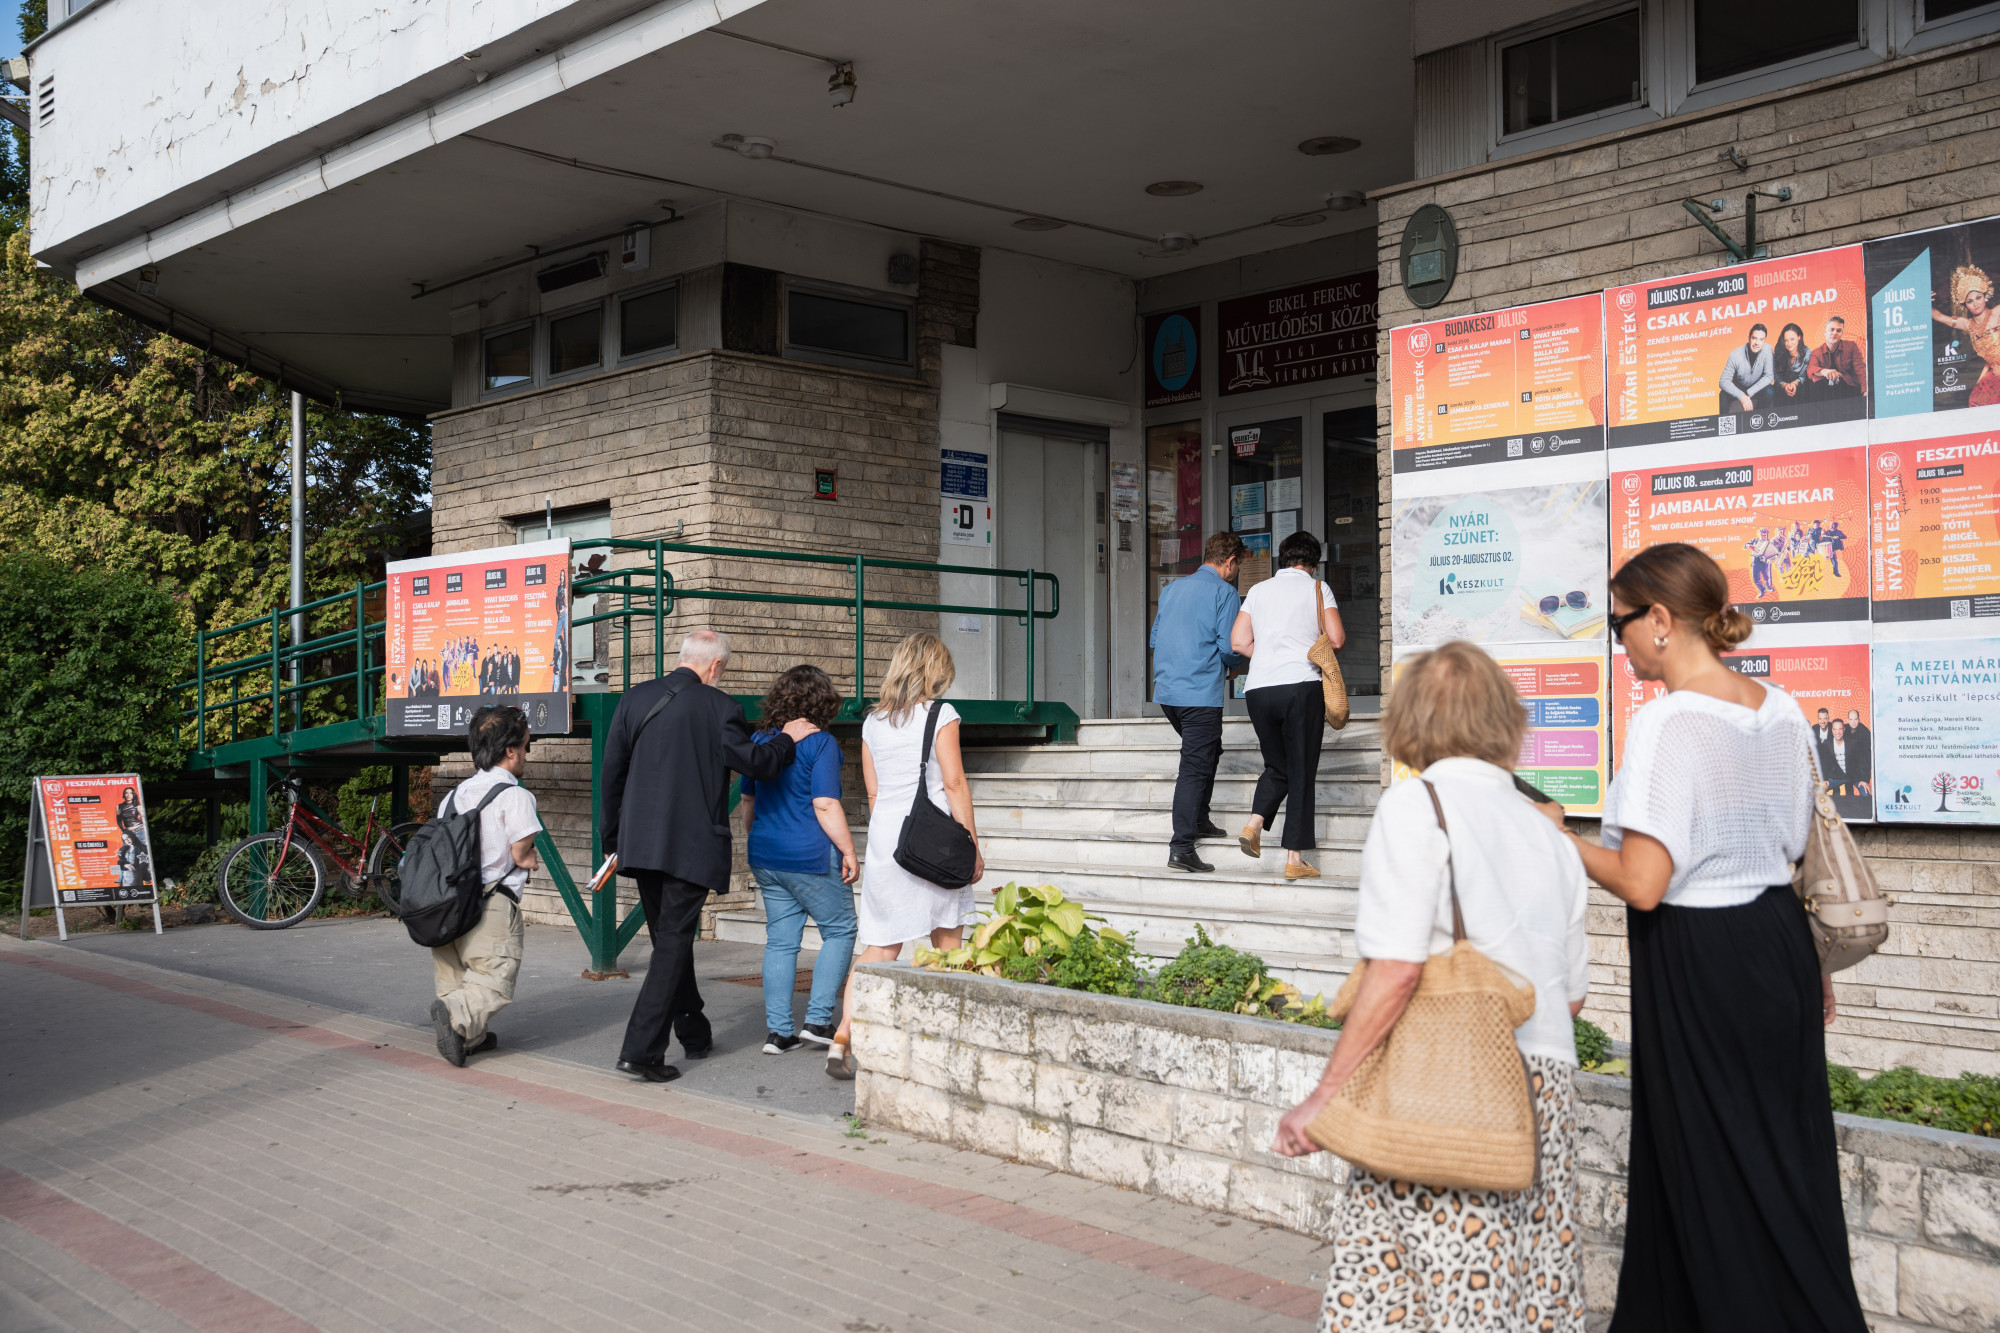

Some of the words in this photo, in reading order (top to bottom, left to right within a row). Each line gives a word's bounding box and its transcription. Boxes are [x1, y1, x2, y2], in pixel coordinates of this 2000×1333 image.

[1650, 288, 1679, 306] JÚLIUS
[1680, 286, 1695, 300] 07.
[1696, 288, 1714, 298] kedd
[1718, 278, 1744, 294] 20:00
[1754, 267, 1807, 288] BUDAKESZI
[1269, 294, 1307, 314] ERKEL
[1313, 283, 1361, 306] FERENC
[1884, 288, 1916, 305] JÚLIUS
[1647, 311, 1691, 331] CSAK
[1695, 309, 1707, 323] A
[1712, 300, 1768, 321] KALAP
[1773, 288, 1838, 311] MARAD
[1445, 316, 1495, 337] BUDAKESZI
[1497, 311, 1528, 329] JÚLIUS
[1884, 307, 1908, 328] 16.
[1227, 312, 1323, 348] MŰVELŐDÉSI
[1521, 330, 1530, 339] 09.
[1533, 332, 1551, 340] VIVAT
[1552, 327, 1580, 337] BACCHUS
[1647, 334, 1670, 346] ZENÉS
[1672, 330, 1708, 342] IRODALMI
[1709, 326, 1733, 339] JÁTÉK
[1885, 326, 1911, 335] csütörtök
[1621, 311, 1638, 365] ESTÉK
[1275, 344, 1315, 362] NAGY
[1436, 344, 1445, 353] 07.
[1448, 346, 1463, 354] CSAK
[1470, 342, 1489, 350] KALAP
[1490, 338, 1512, 347] MARAD
[1554, 346, 1570, 354] GÉZA
[1275, 364, 1323, 384] VÁROSI
[1413, 360, 1425, 399] ESTÉK
[1624, 371, 1638, 420] NYÁRI
[1935, 385, 1966, 394] BUDAKESZI
[1522, 394, 1531, 402] 10.
[1535, 395, 1551, 403] TÓTH
[1552, 392, 1572, 400] ABIGÉL
[1648, 397, 1666, 405] SZABÓ
[1439, 406, 1447, 414] 08.
[1450, 405, 1482, 416] JAMBALAYA
[1483, 401, 1510, 410] ZENEKAR
[1535, 403, 1555, 411] KISZEL
[1556, 399, 1584, 410] JENNIFER
[1415, 404, 1425, 441] NYÁRI
[1237, 444, 1256, 453] ALARM
[1916, 439, 2000, 463] FESZTIVÁL
[1654, 474, 1682, 491] JÚLIUS
[1684, 475, 1697, 488] 08.
[1700, 478, 1724, 487] szerda
[1725, 469, 1752, 485] 20:00
[1757, 464, 1809, 482] BUDAKESZI
[1918, 469, 1936, 479] JÚLIUS
[1938, 468, 1946, 477] 10.
[1920, 488, 1940, 496] 19:00
[1649, 496, 1747, 519] JAMBALAYA
[1752, 487, 1834, 508] ZENEKAR
[1882, 476, 1900, 532] ESTÉK
[1920, 497, 1940, 505] 19:15
[959, 504, 974, 529] D
[1450, 510, 1489, 528] NYÁRI
[1625, 496, 1641, 549] ESTÉK
[1671, 520, 1704, 529] ORLEANS
[1706, 518, 1729, 526] MUSIC
[1874, 520, 1883, 543] JÚLIUS
[1942, 519, 1970, 530] TÓTH
[1444, 530, 1499, 546] SZÜNET:
[1943, 530, 1981, 542] ABIGÉL
[1429, 554, 1451, 567] JÚLIUS
[1452, 552, 1502, 565] 20-AUGUSZTUS
[1503, 552, 1514, 562] 02.
[1875, 549, 1884, 581] KISVÁROSI
[1884, 538, 1903, 590] NYÁRI
[1943, 553, 1978, 563] KISZEL
[1943, 564, 1992, 577] JENNIFER
[1876, 583, 1884, 591] III.
[393, 576, 401, 619] ESTÉK
[484, 596, 498, 604] VIVAT
[525, 590, 548, 600] FESZTIVÁL
[446, 599, 469, 608] JAMBALAYA
[525, 600, 540, 609] FINÁLÉ
[525, 620, 537, 628] TÓTH
[538, 618, 553, 626] ABIGÉL
[393, 624, 401, 664] NYÁRI
[524, 656, 545, 664] JENNIFER
[1741, 660, 1768, 674] 20:00
[1775, 658, 1828, 672] BUDAKESZI
[1896, 662, 1904, 672] A
[1911, 660, 1954, 672] MEZEI
[1896, 672, 2000, 686] TANÍTVÁNYAI
[1791, 688, 1852, 698] ÉNEKEGYÜTTES
[1908, 693, 1958, 702] KesziKult
[66, 779, 106, 787] FESZTIVÁL
[1960, 776, 1980, 789] 30
[51, 798, 70, 841] ESTÉK
[59, 846, 78, 885] NYÁRI
